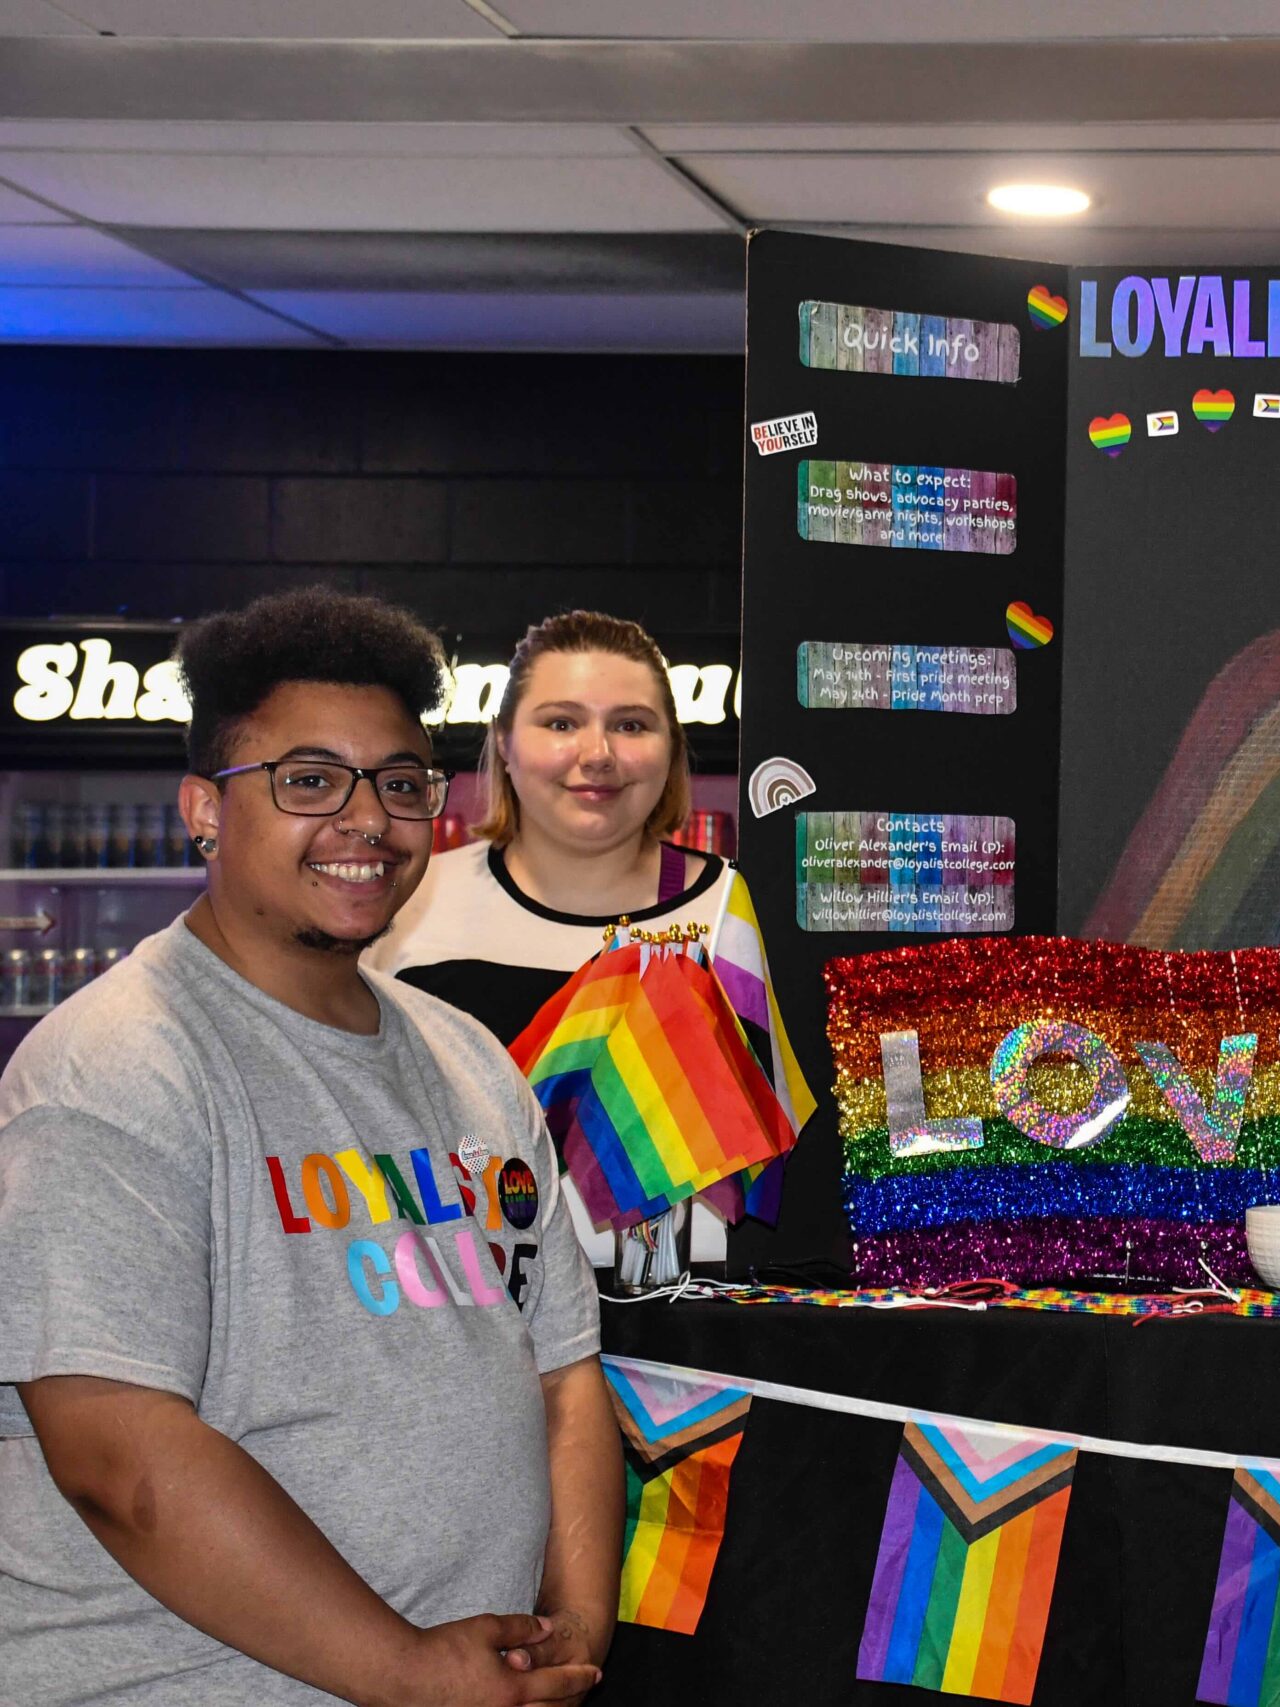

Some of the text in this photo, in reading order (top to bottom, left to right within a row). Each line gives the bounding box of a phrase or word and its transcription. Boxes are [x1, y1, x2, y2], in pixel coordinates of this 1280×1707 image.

[843, 323, 980, 365] Quick Info
[754, 415, 815, 441] BELIEVE IN
[758, 429, 816, 453] YOURSELF
[849, 466, 971, 491] What to expect:
[810, 485, 1014, 513] Drag shows, advocacy parties,
[808, 504, 1015, 532] movie/game nights, workshops
[880, 529, 904, 541] and
[832, 648, 991, 669] Upcoming meetings:
[14, 638, 193, 722] Sha
[813, 668, 841, 684] May
[846, 669, 872, 682] 14th
[886, 669, 917, 682] First
[921, 671, 953, 685] pride
[957, 672, 1010, 689] meeting
[819, 687, 848, 704] May
[852, 687, 879, 700] 24th
[930, 689, 971, 703] Month
[975, 693, 1004, 707] prep
[877, 819, 945, 833] Contacts
[815, 838, 854, 852] Oliver
[858, 839, 937, 852] Alexander's
[941, 840, 977, 852] Email
[820, 891, 863, 903] Willow
[867, 890, 918, 903] Hillier's
[922, 891, 959, 903] Email
[265, 1147, 503, 1234] LOYALST
[502, 1168, 535, 1195] LOVE
